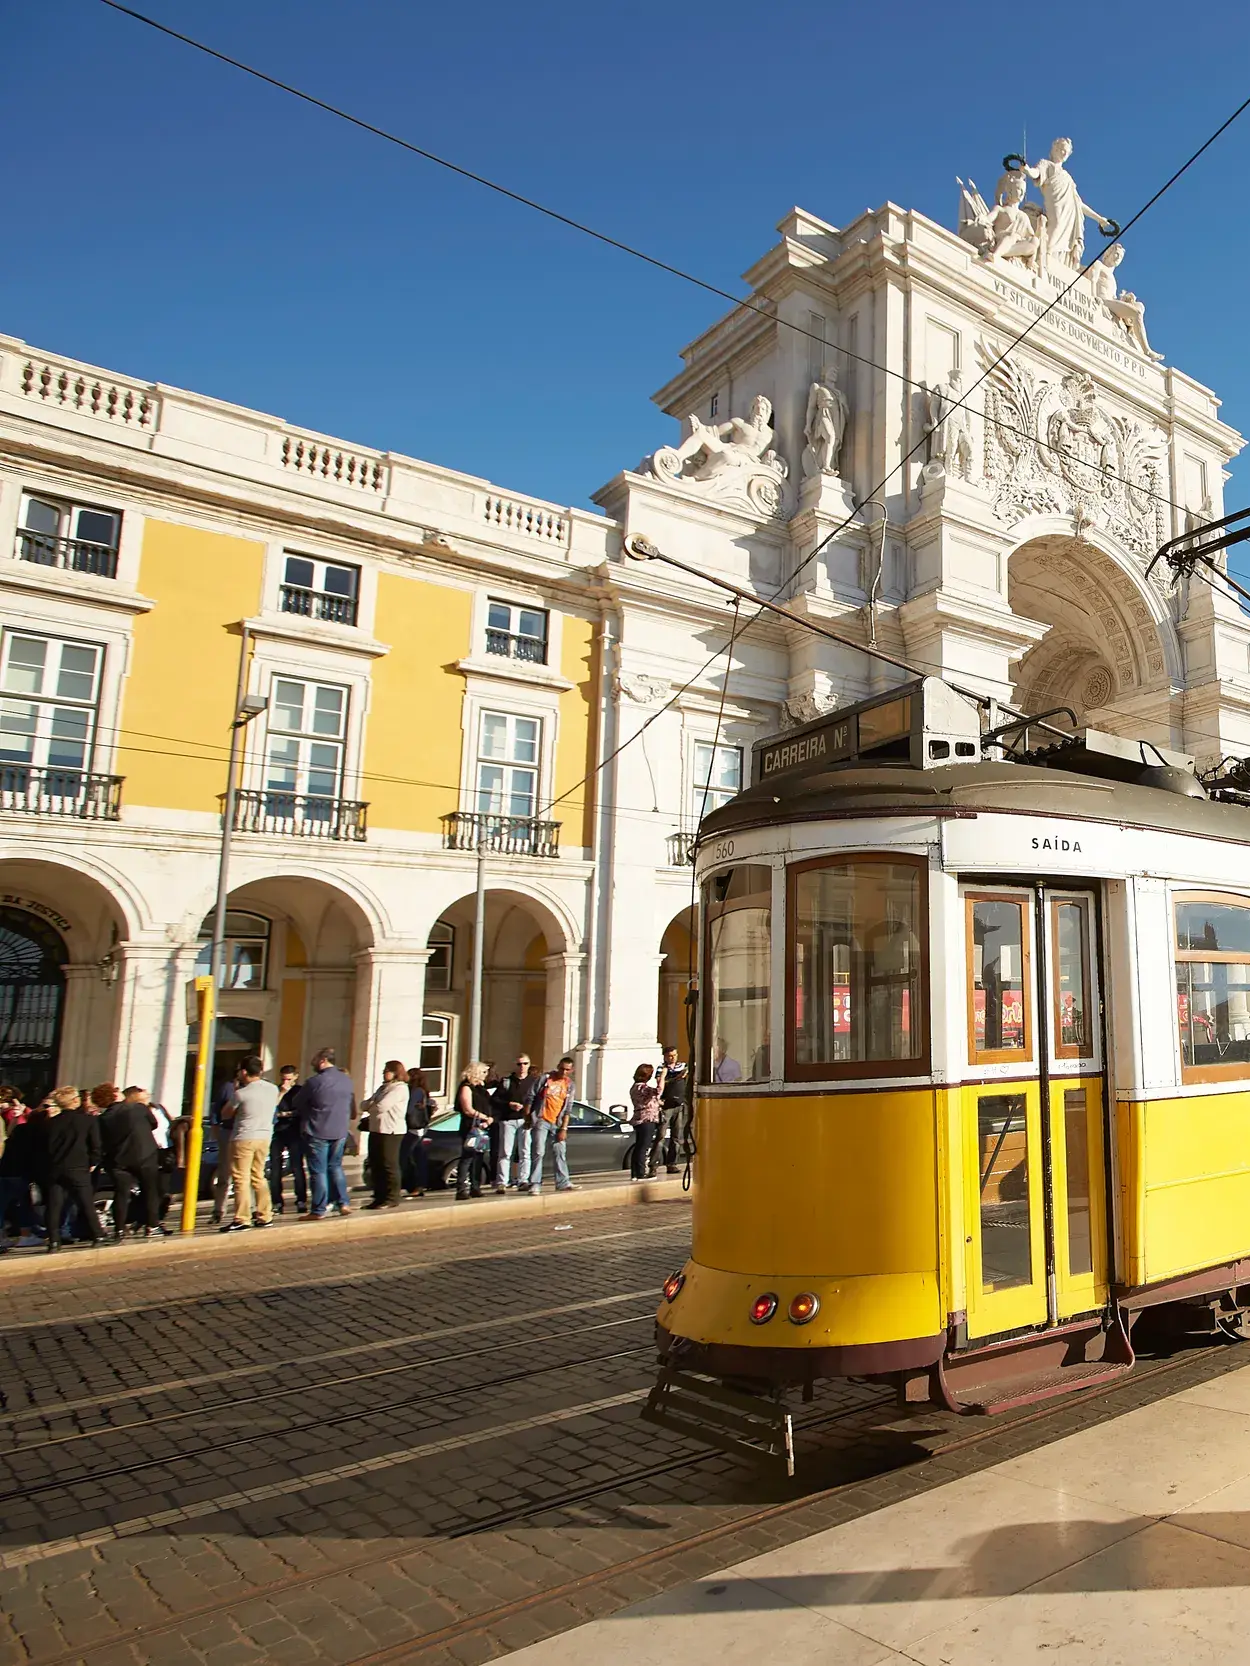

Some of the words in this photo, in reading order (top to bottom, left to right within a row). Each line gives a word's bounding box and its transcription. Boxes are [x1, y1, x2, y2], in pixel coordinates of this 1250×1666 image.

[764, 734, 826, 773] CARREIRA
[715, 840, 735, 860] 560
[1031, 835, 1082, 853] SAÍDA
